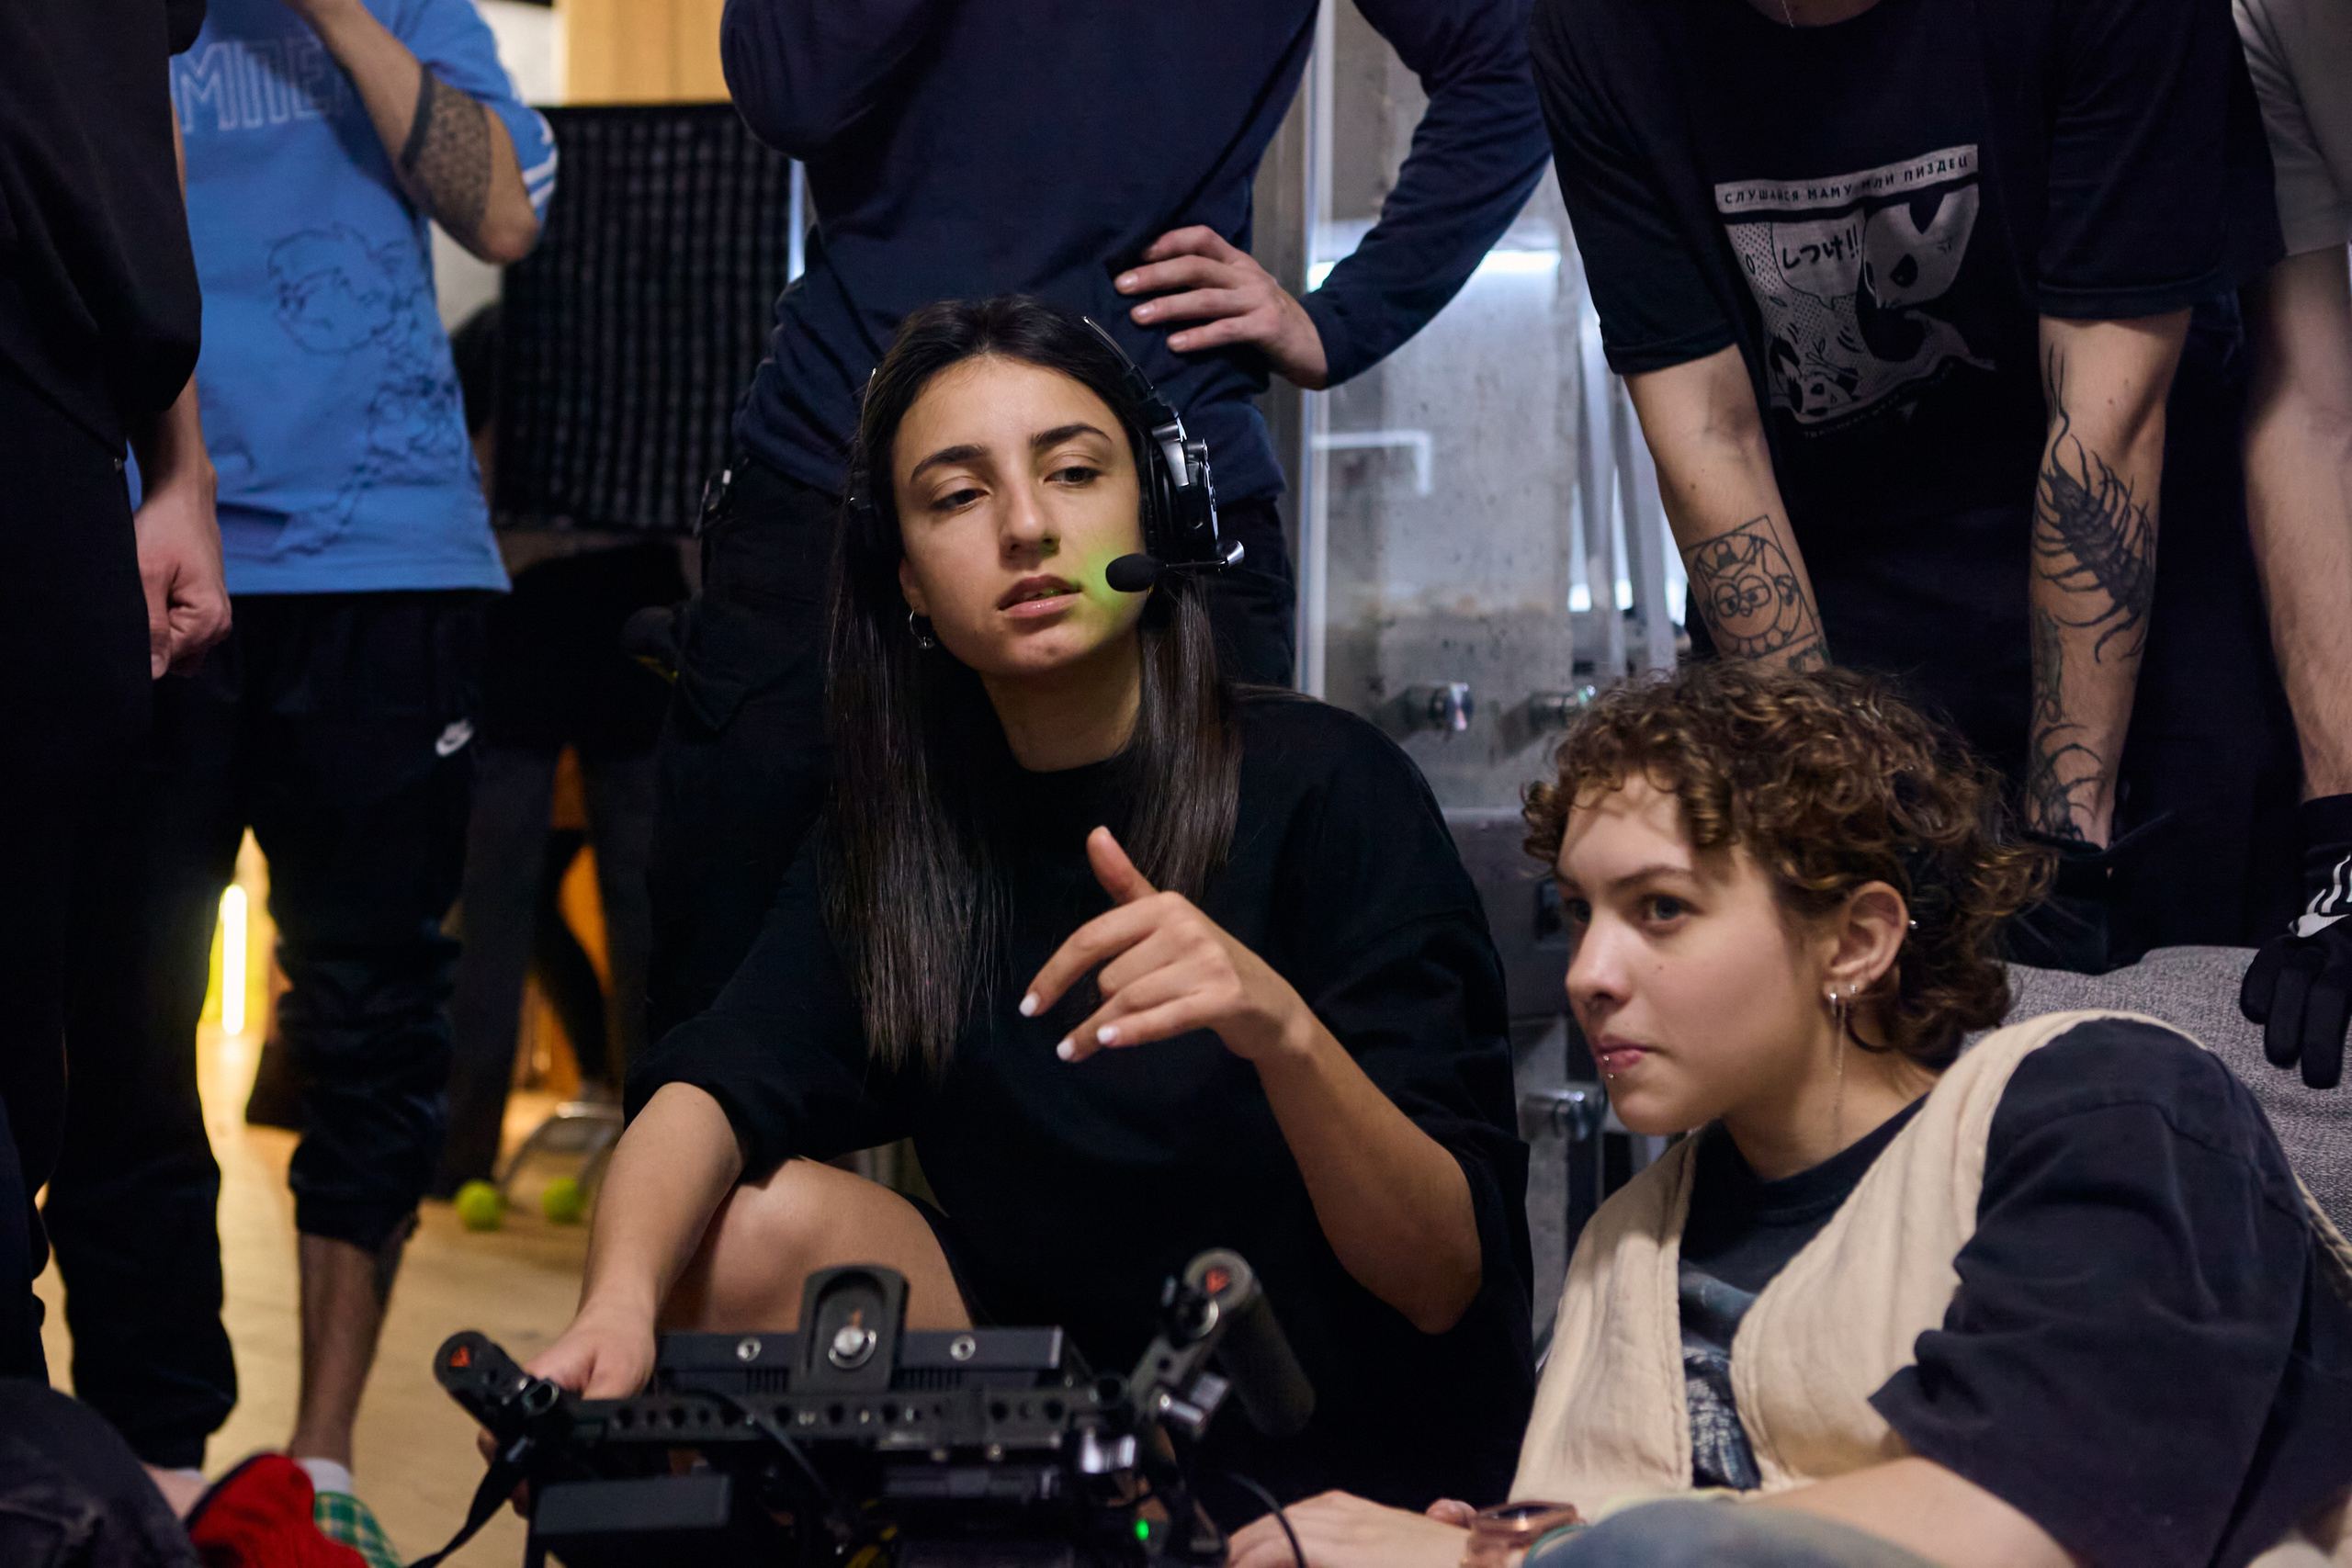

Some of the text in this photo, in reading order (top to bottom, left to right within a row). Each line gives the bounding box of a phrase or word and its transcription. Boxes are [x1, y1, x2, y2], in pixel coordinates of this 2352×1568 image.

[1807, 183, 1852, 201] МАМУ
[1861, 173, 1894, 189] ИЛИ
[1904, 154, 1969, 182] ПИЗДЕЦ
